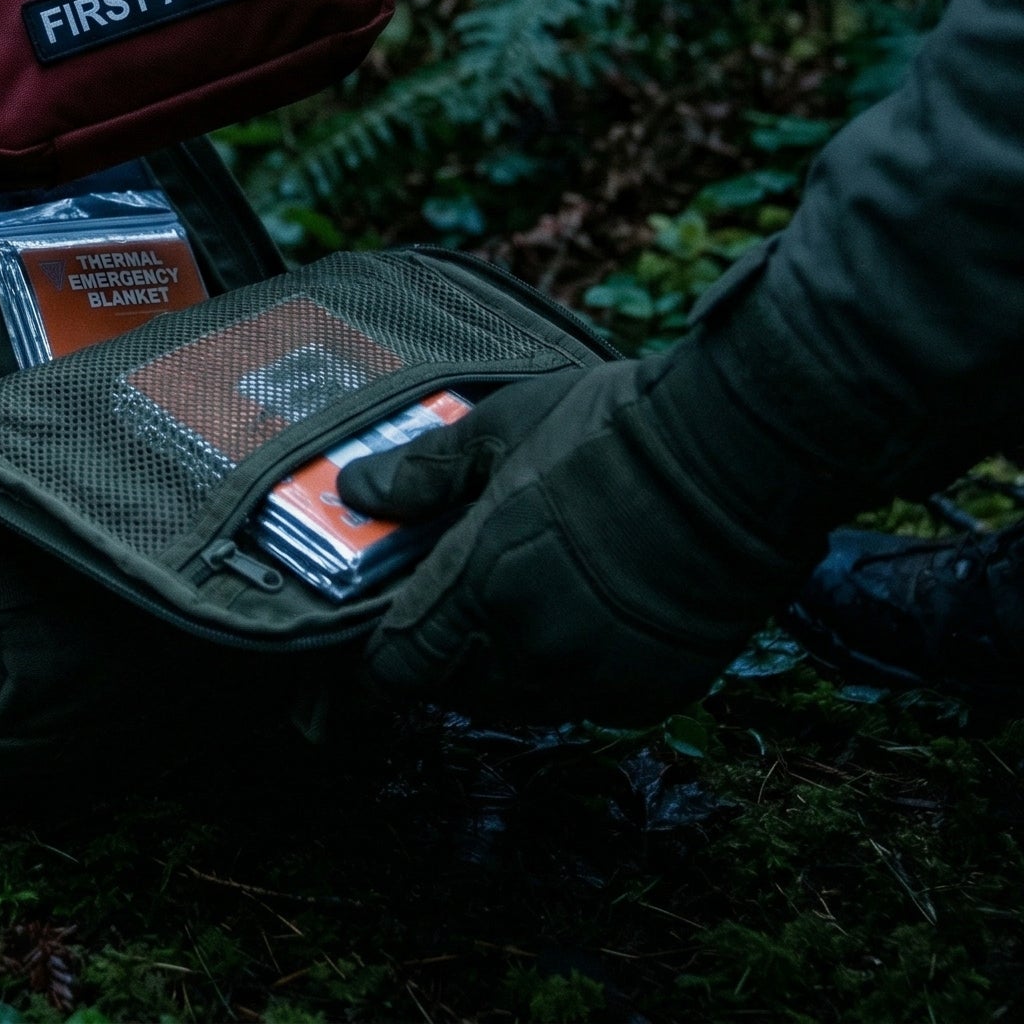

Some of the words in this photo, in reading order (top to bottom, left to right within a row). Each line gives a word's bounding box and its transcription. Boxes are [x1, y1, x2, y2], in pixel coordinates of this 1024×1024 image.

[76, 250, 163, 271] THERMAL
[68, 267, 179, 291] EMERGENCY
[87, 286, 169, 308] BLANKET
